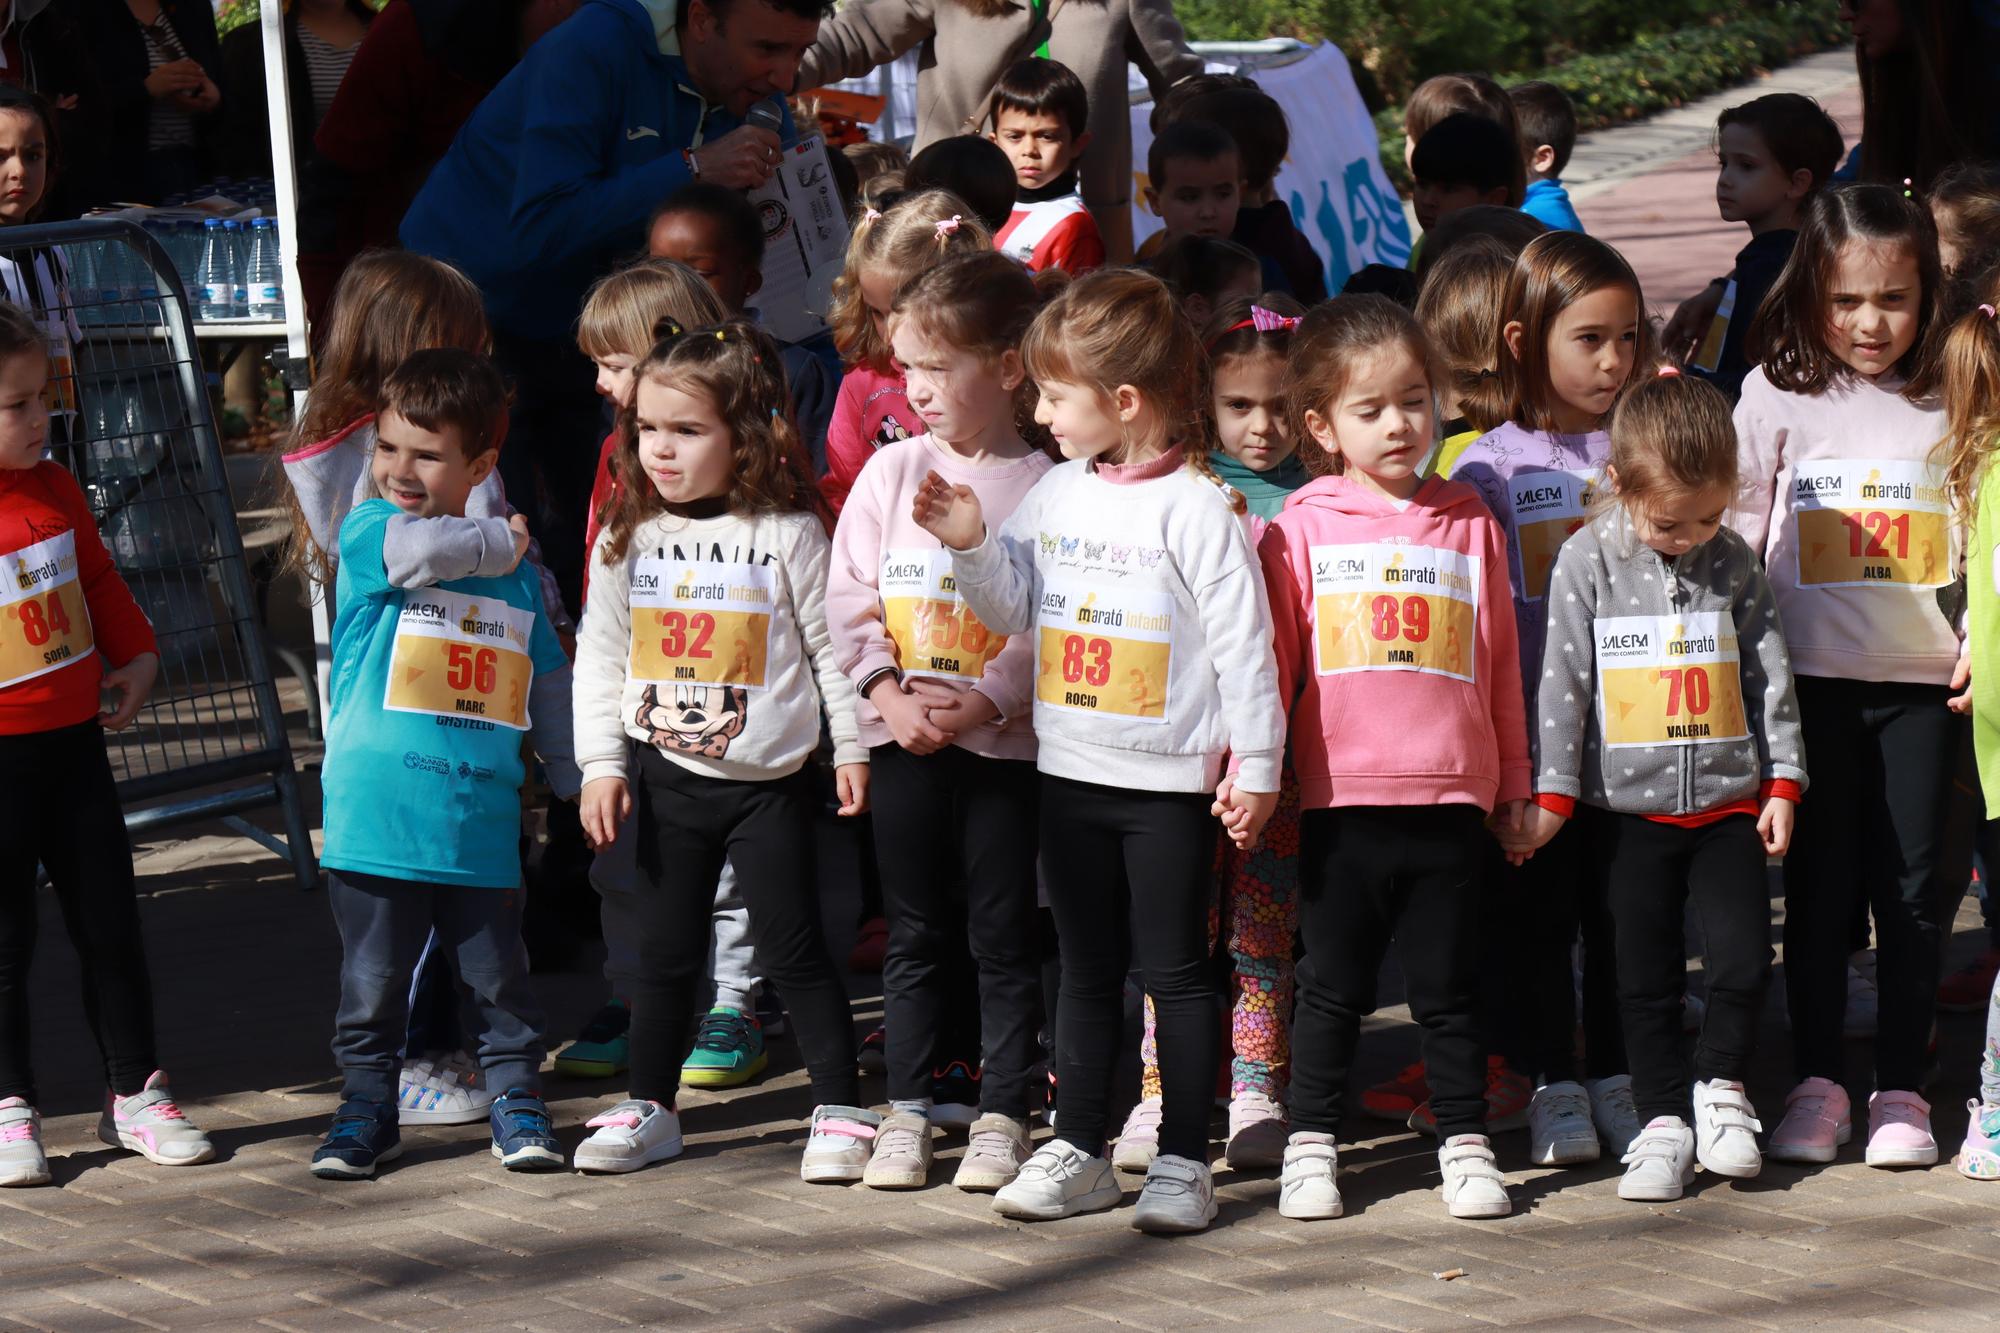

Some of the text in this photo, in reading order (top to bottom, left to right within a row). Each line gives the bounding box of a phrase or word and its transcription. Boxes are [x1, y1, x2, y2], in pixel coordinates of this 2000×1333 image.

[1797, 476, 1842, 492] SALERA
[1863, 483, 1911, 500] marató
[1516, 486, 1562, 506] SALERA
[1841, 511, 1911, 560] 121
[20, 558, 59, 588] marató
[886, 563, 925, 578] SALERA
[1385, 567, 1436, 585] marató
[1864, 566, 1892, 579] ALBA
[676, 582, 769, 603] marató Infantil
[18, 591, 71, 647] 84
[1078, 605, 1172, 632] marató Infantil
[1371, 594, 1430, 643] 89
[462, 620, 505, 638] marató
[661, 611, 716, 659] 32
[1601, 633, 1649, 650] SALERA
[1669, 635, 1715, 655] marató
[43, 644, 71, 665] SOFÍA
[1062, 634, 1113, 687] 83
[1387, 650, 1414, 663] MAR
[447, 643, 499, 694] 56
[675, 666, 696, 680] MIA
[930, 656, 960, 673] VEGA
[1065, 692, 1098, 708] ROCIO
[1660, 666, 1710, 717] 70
[455, 698, 486, 715] MARC
[1667, 723, 1711, 739] VALERIA
